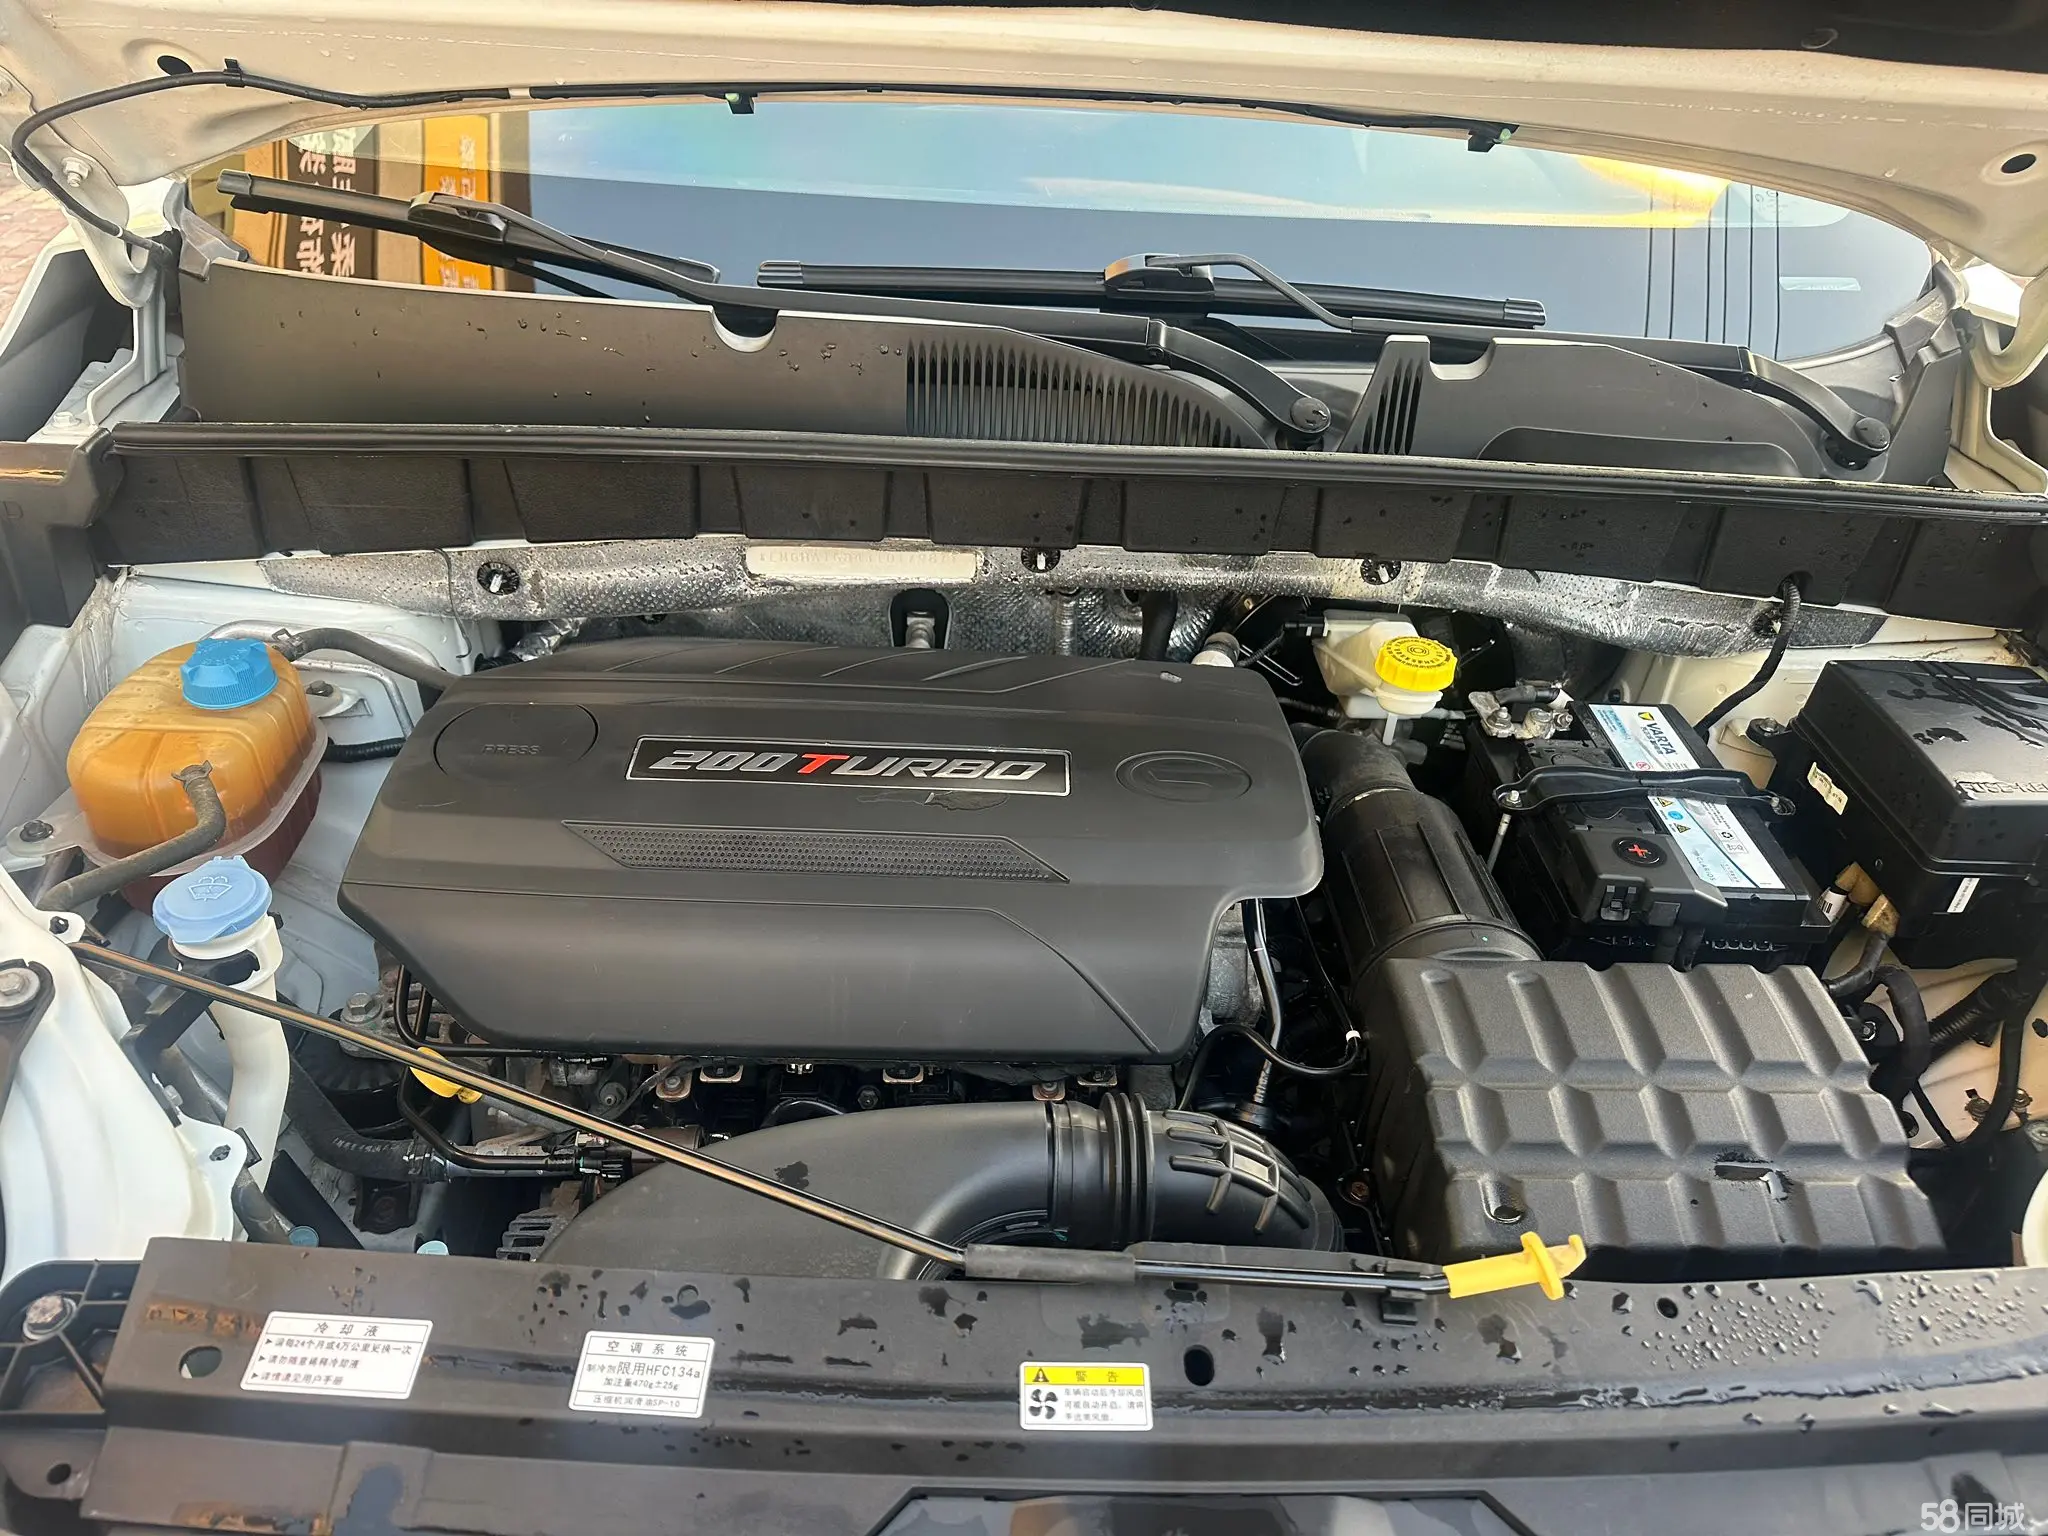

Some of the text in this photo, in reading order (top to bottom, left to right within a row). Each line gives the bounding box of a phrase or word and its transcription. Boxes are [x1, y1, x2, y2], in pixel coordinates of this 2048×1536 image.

[1645, 721, 1677, 755] VARTA
[481, 743, 542, 756] PRESS
[648, 749, 1047, 781] 200TURBO
[313, 1321, 381, 1337] 冷却液
[605, 1340, 689, 1357] 空调系统
[1075, 1370, 1119, 1383] 警告
